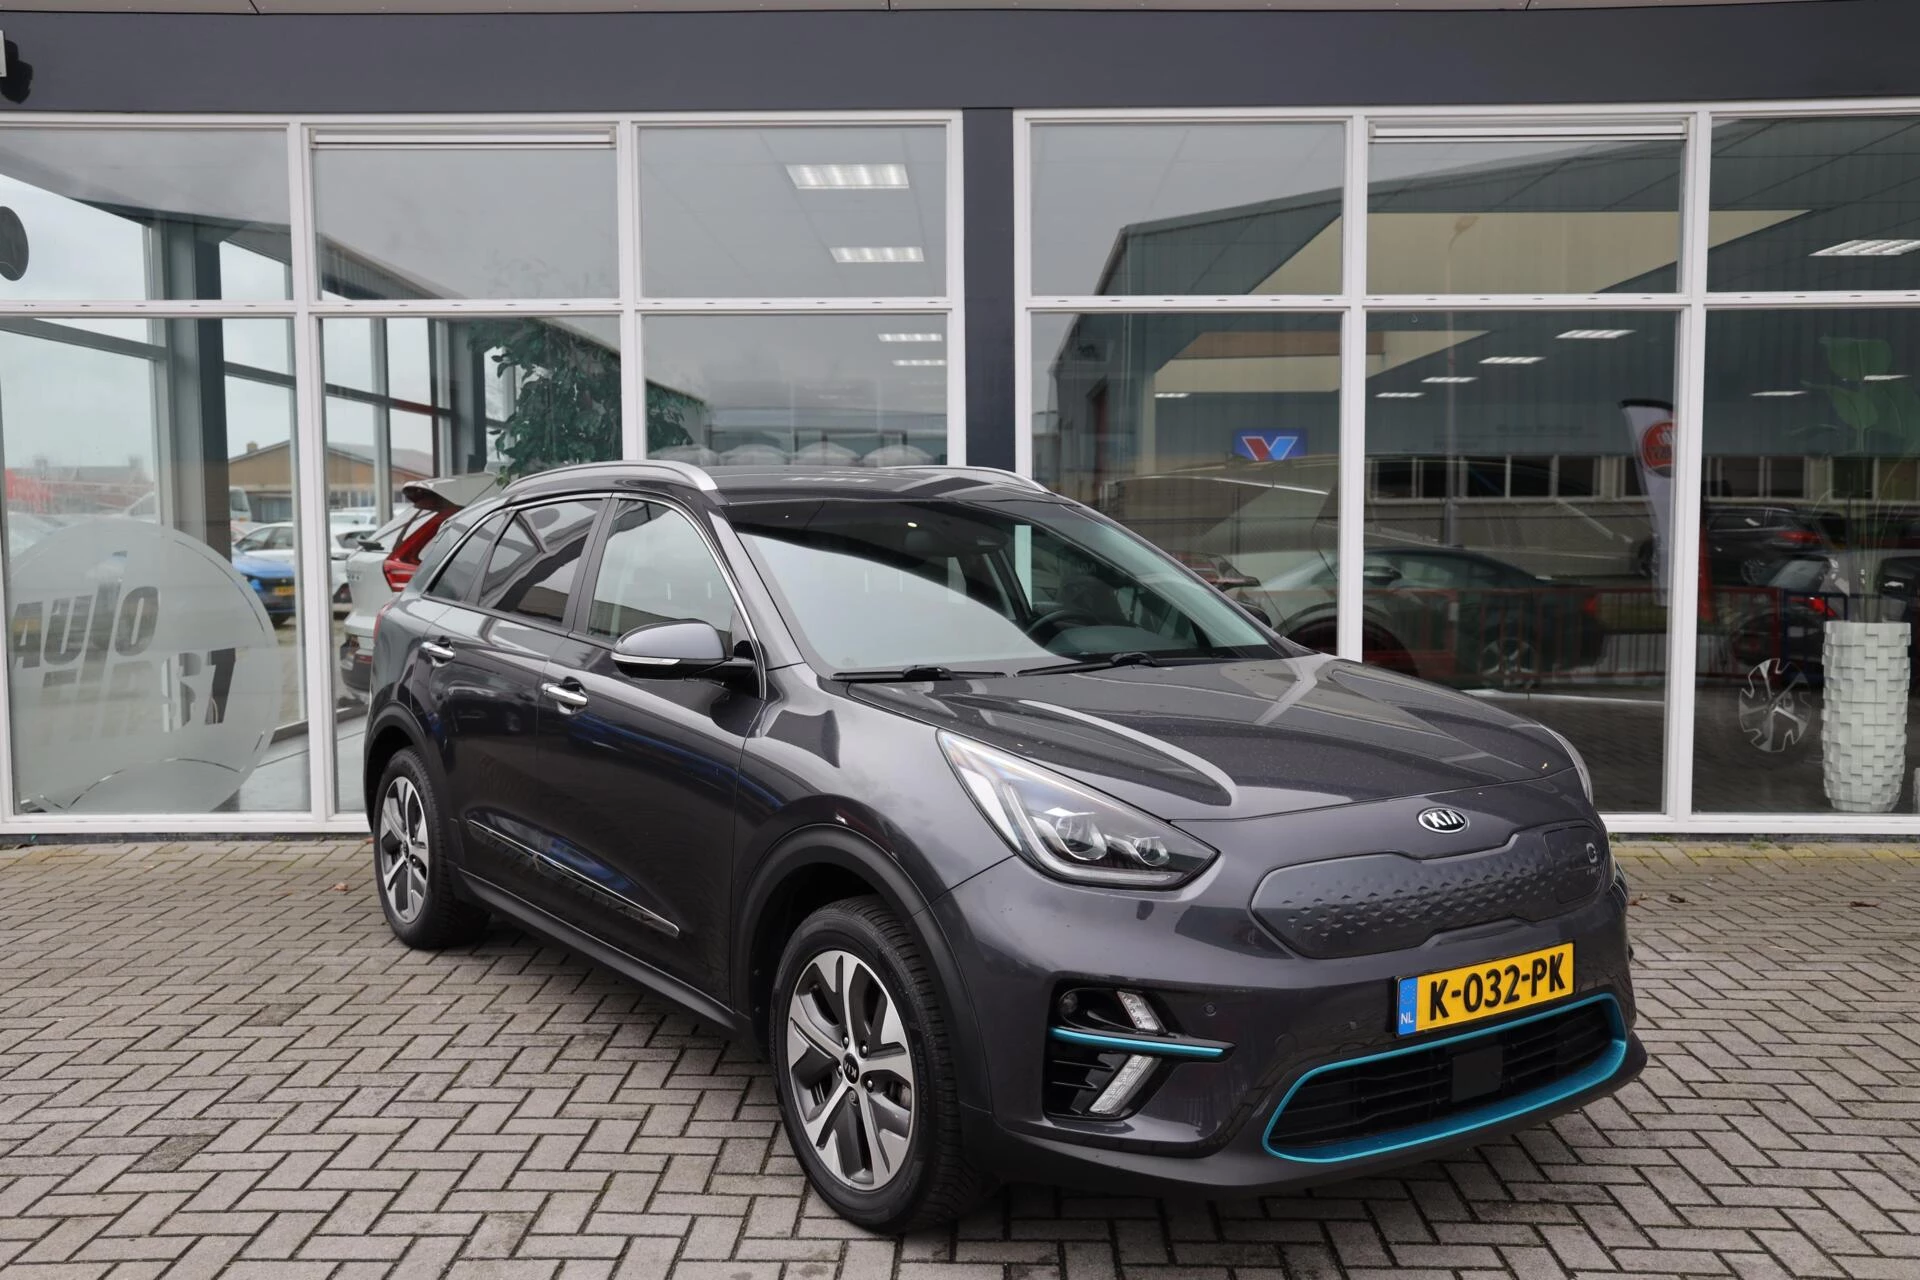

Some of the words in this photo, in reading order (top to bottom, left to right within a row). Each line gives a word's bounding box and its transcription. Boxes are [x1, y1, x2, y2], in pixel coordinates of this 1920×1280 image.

[1422, 810, 1465, 828] KIA
[1429, 952, 1566, 1021] K-032-PK
[1400, 1012, 1415, 1025] NL
